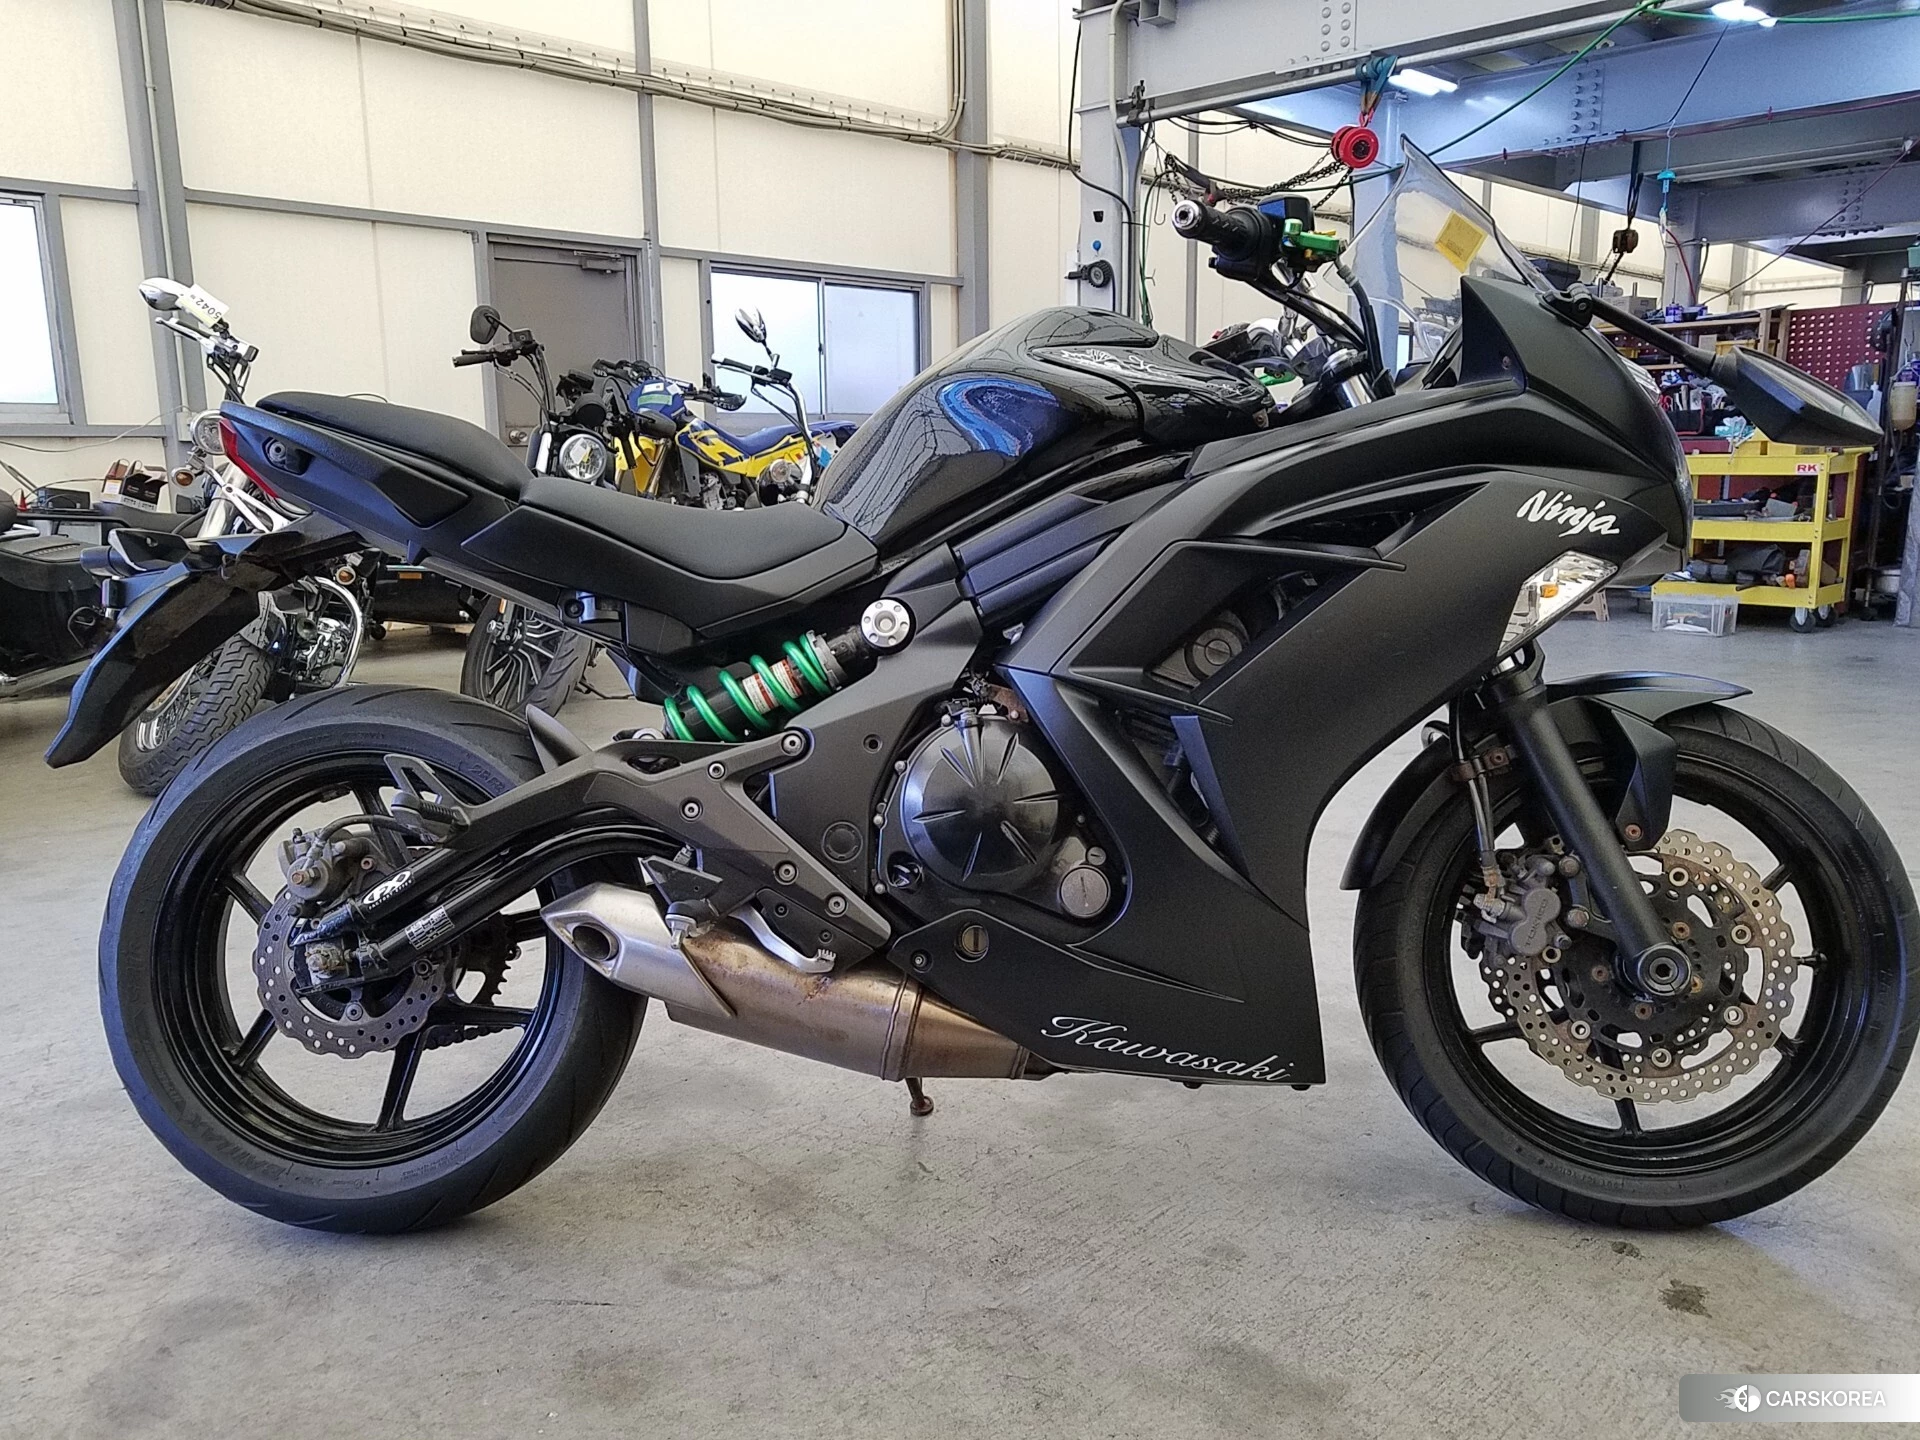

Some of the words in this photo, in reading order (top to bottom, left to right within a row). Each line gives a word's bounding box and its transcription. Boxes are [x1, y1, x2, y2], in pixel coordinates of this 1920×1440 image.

[1797, 464, 1817, 472] RK
[1516, 490, 1620, 537] Ninja
[1041, 1016, 1294, 1081] Kawasaki
